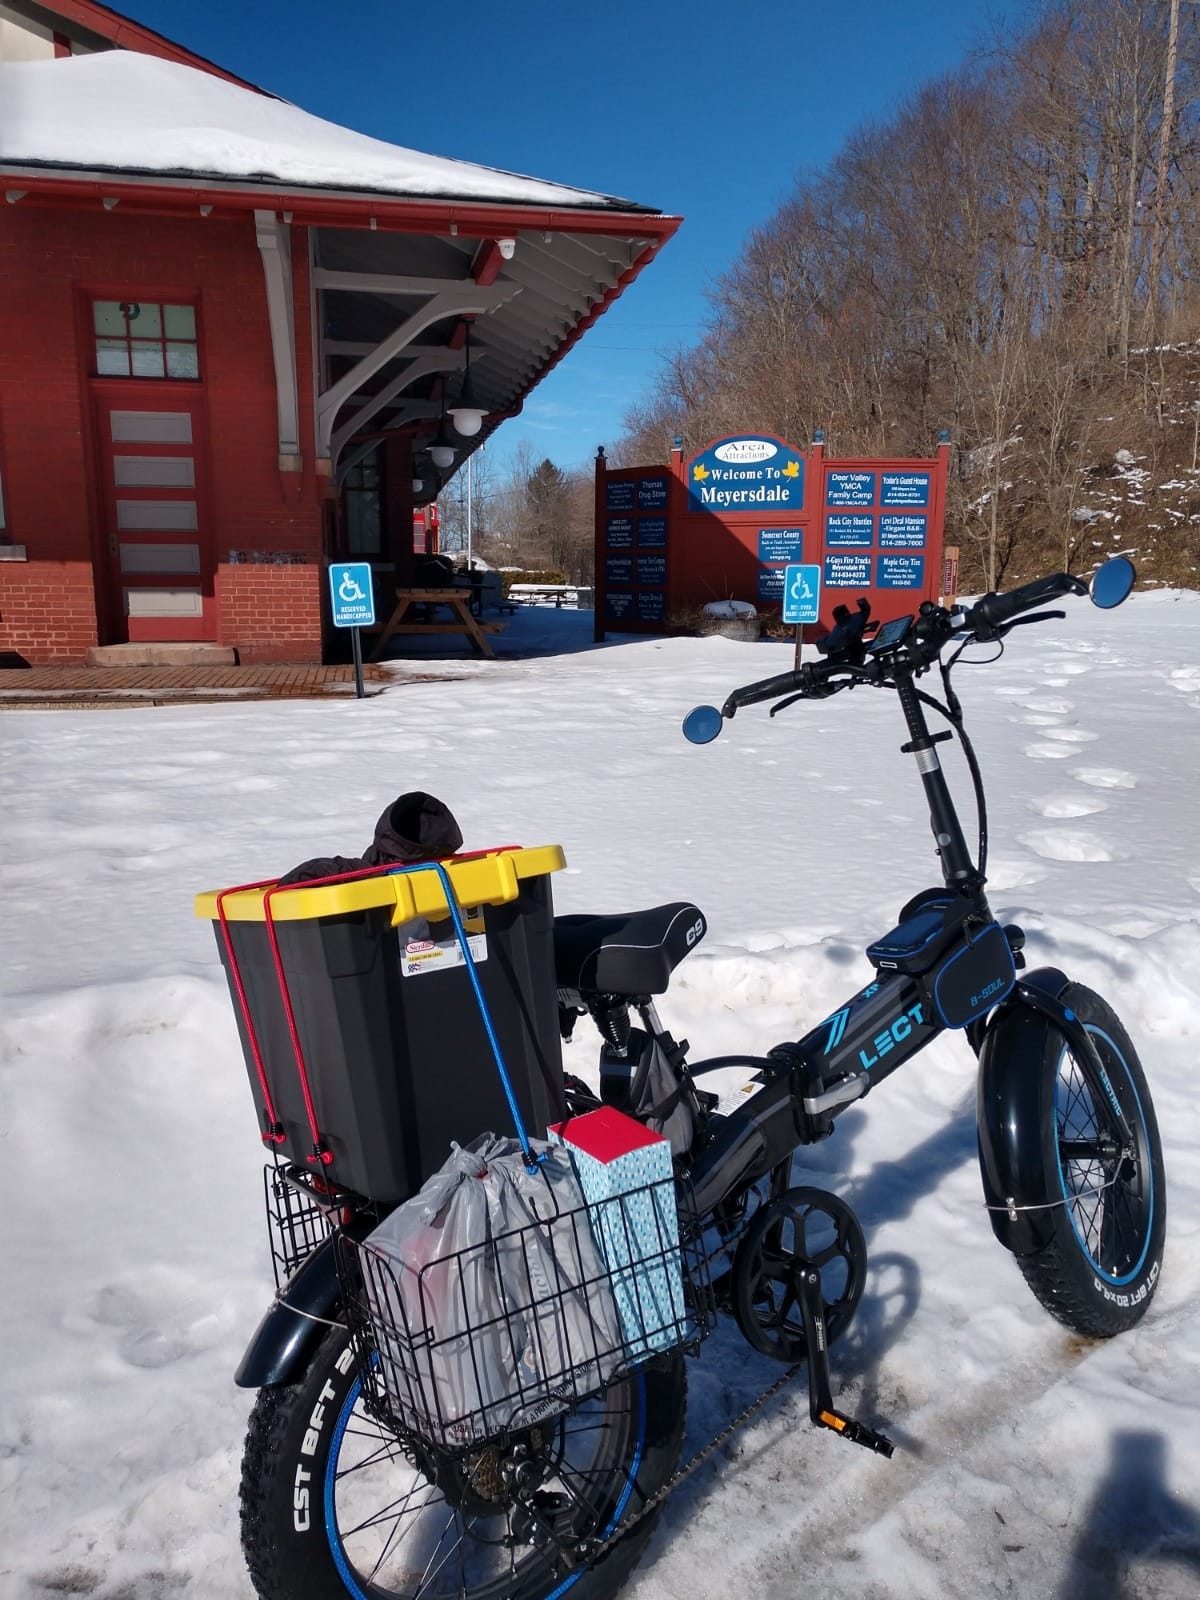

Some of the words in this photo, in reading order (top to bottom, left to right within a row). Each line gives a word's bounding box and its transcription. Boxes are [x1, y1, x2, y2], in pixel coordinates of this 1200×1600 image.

[726, 443, 765, 452] Area
[722, 451, 769, 460] Attractions
[711, 468, 763, 481] Welcome
[765, 467, 781, 479] To
[850, 473, 871, 482] Valley
[840, 482, 862, 490] YMCA
[700, 485, 790, 507] Meyersdale
[828, 490, 851, 499] Family
[852, 491, 872, 499] Camp
[841, 516, 852, 527] City
[783, 530, 800, 541] County
[843, 556, 854, 564] Fire
[854, 556, 871, 565] Trucks
[899, 558, 910, 568] City
[340, 605, 367, 613] RESERVED
[336, 612, 372, 620] HANDICAPPED
[970, 977, 1006, 1007] B-SOUL
[1146, 1260, 1159, 1292] CST
[1130, 1283, 1147, 1306] BFT
[300, 1377, 336, 1457] BFT
[293, 1463, 312, 1532] CST
